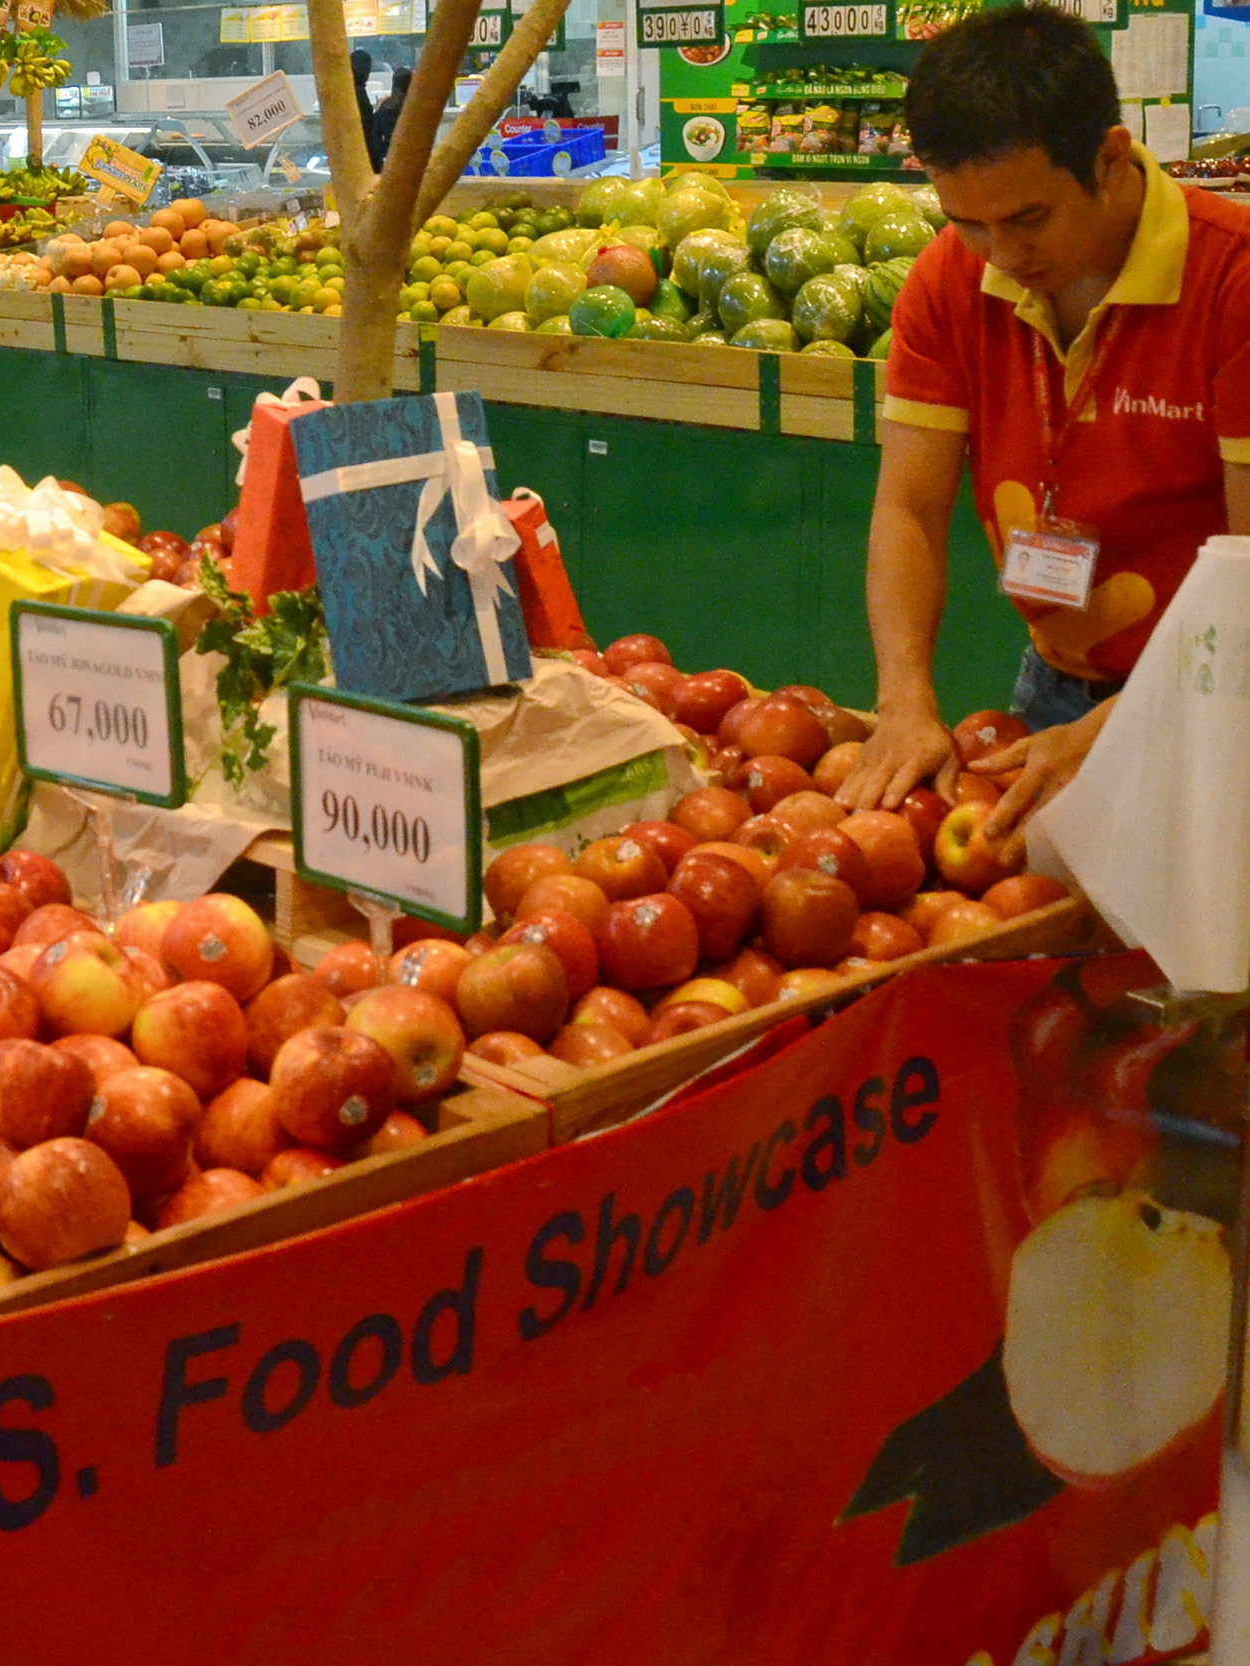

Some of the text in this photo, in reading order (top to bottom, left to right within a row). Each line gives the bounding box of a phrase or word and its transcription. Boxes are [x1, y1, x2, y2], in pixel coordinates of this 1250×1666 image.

[247, 100, 286, 130] 82,000
[504, 123, 532, 133] Counter
[49, 692, 148, 749] 67,000
[321, 788, 431, 865] 90,000
[154, 1246, 485, 1469] Food
[521, 1056, 942, 1339] Showcase
